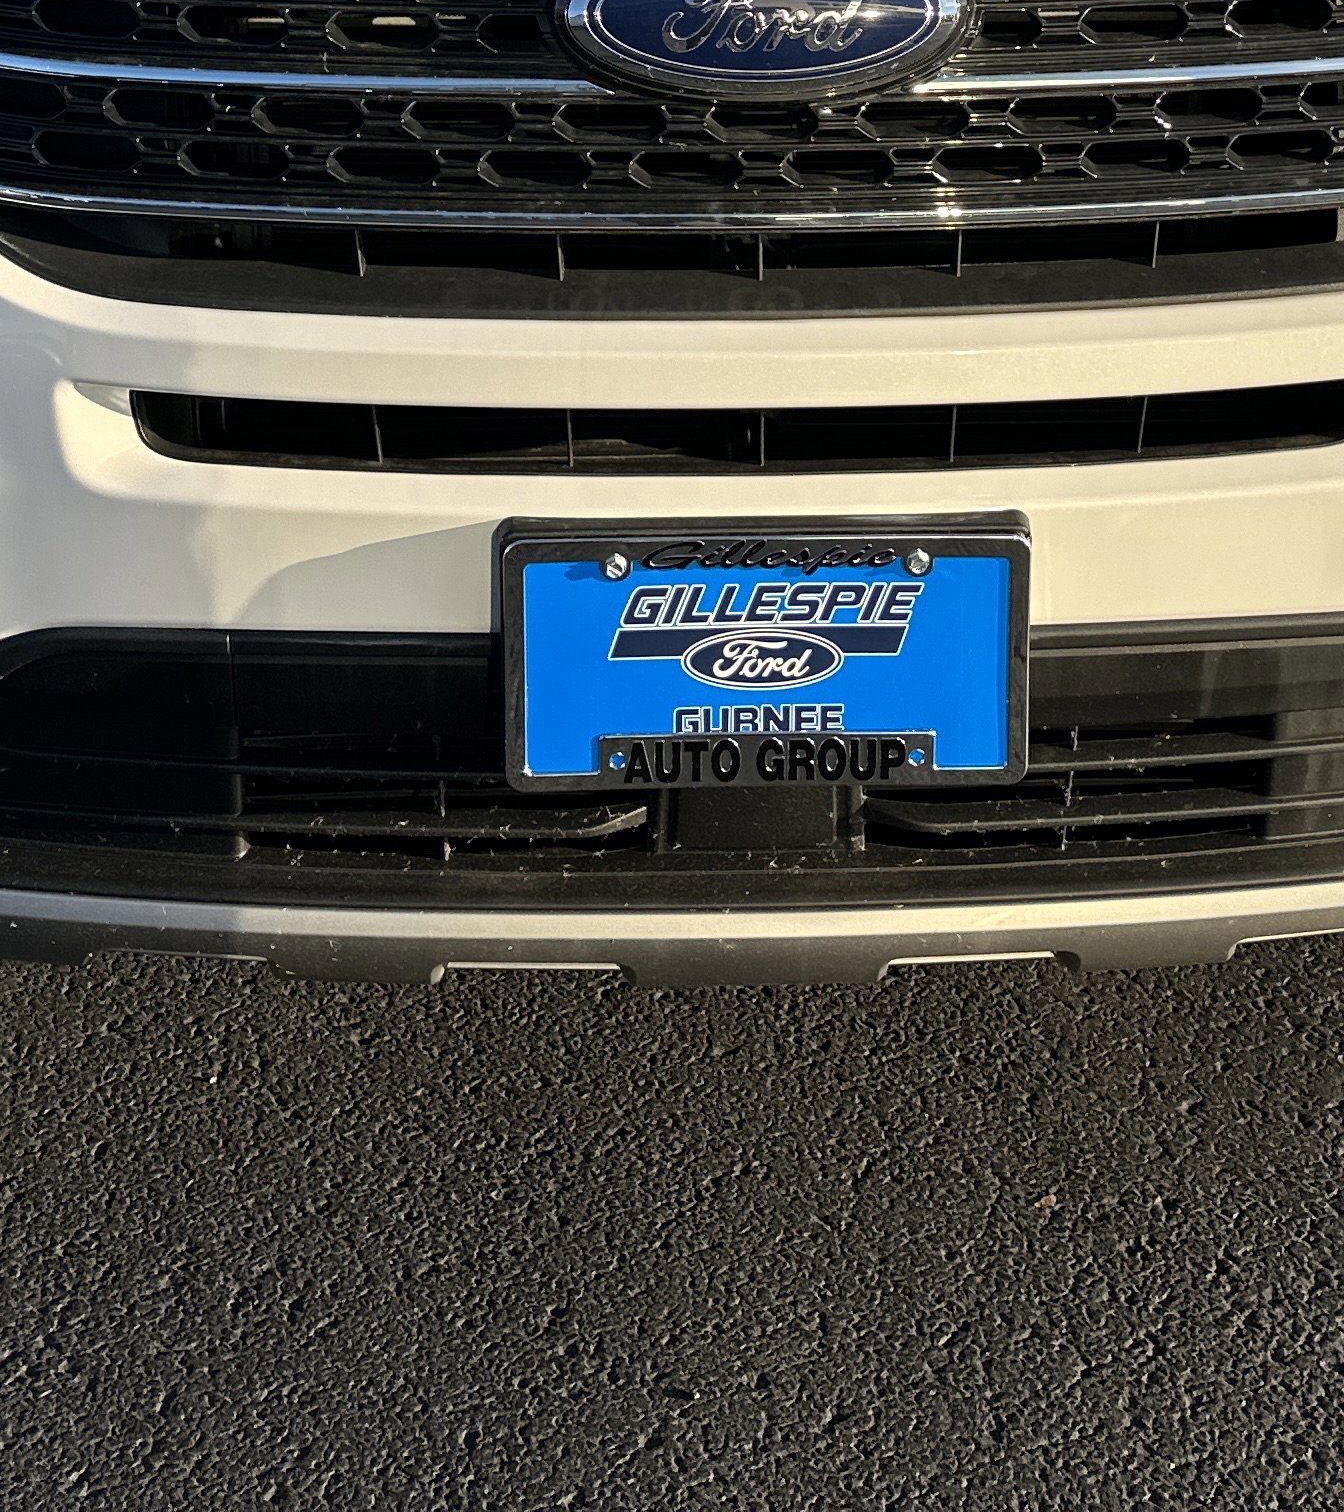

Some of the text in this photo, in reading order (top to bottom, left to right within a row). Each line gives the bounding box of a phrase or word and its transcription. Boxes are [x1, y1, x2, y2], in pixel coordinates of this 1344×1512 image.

[641, 540, 898, 575] Gillespie
[620, 582, 925, 627] GILLESPIE
[712, 639, 813, 678] Ford
[673, 703, 845, 734] GURNEE
[623, 737, 907, 784] AUTO GROUP
